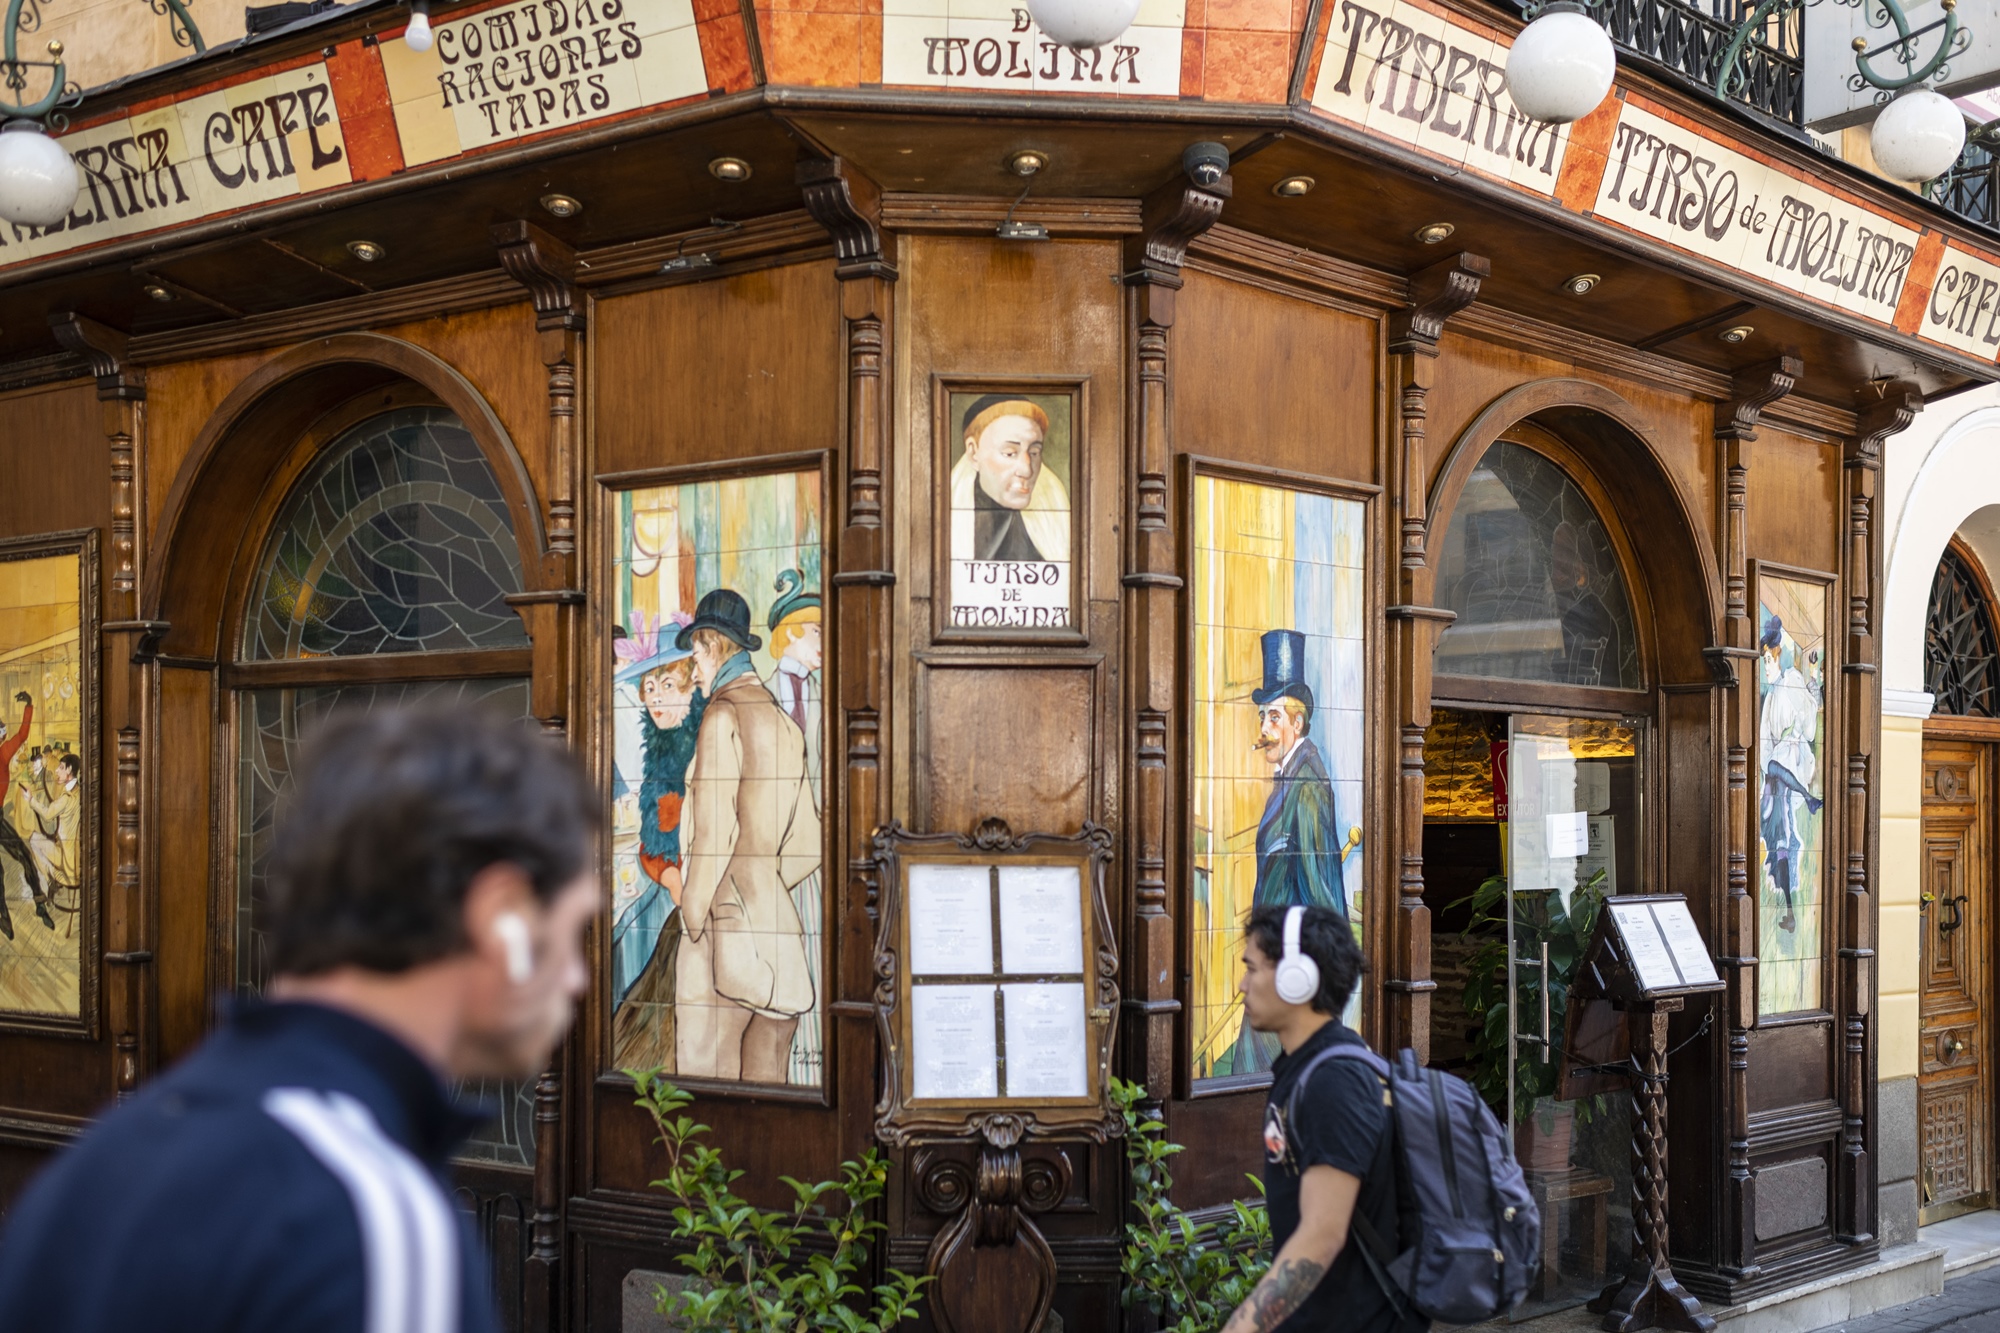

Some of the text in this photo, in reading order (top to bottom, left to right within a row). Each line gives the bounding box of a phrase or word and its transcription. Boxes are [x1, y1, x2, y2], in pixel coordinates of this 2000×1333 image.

[437, 0, 623, 64] COMIDAS
[923, 37, 1141, 84] MOLINA
[437, 21, 643, 109] RACIONES
[204, 72, 343, 189] CAFÉ
[479, 74, 611, 137] TAPAS
[1608, 121, 1915, 308] TIRSO de MOLINA
[964, 562, 1060, 586] TIRSO
[1001, 588, 1022, 602] DE
[952, 605, 1069, 628] MOLINA
